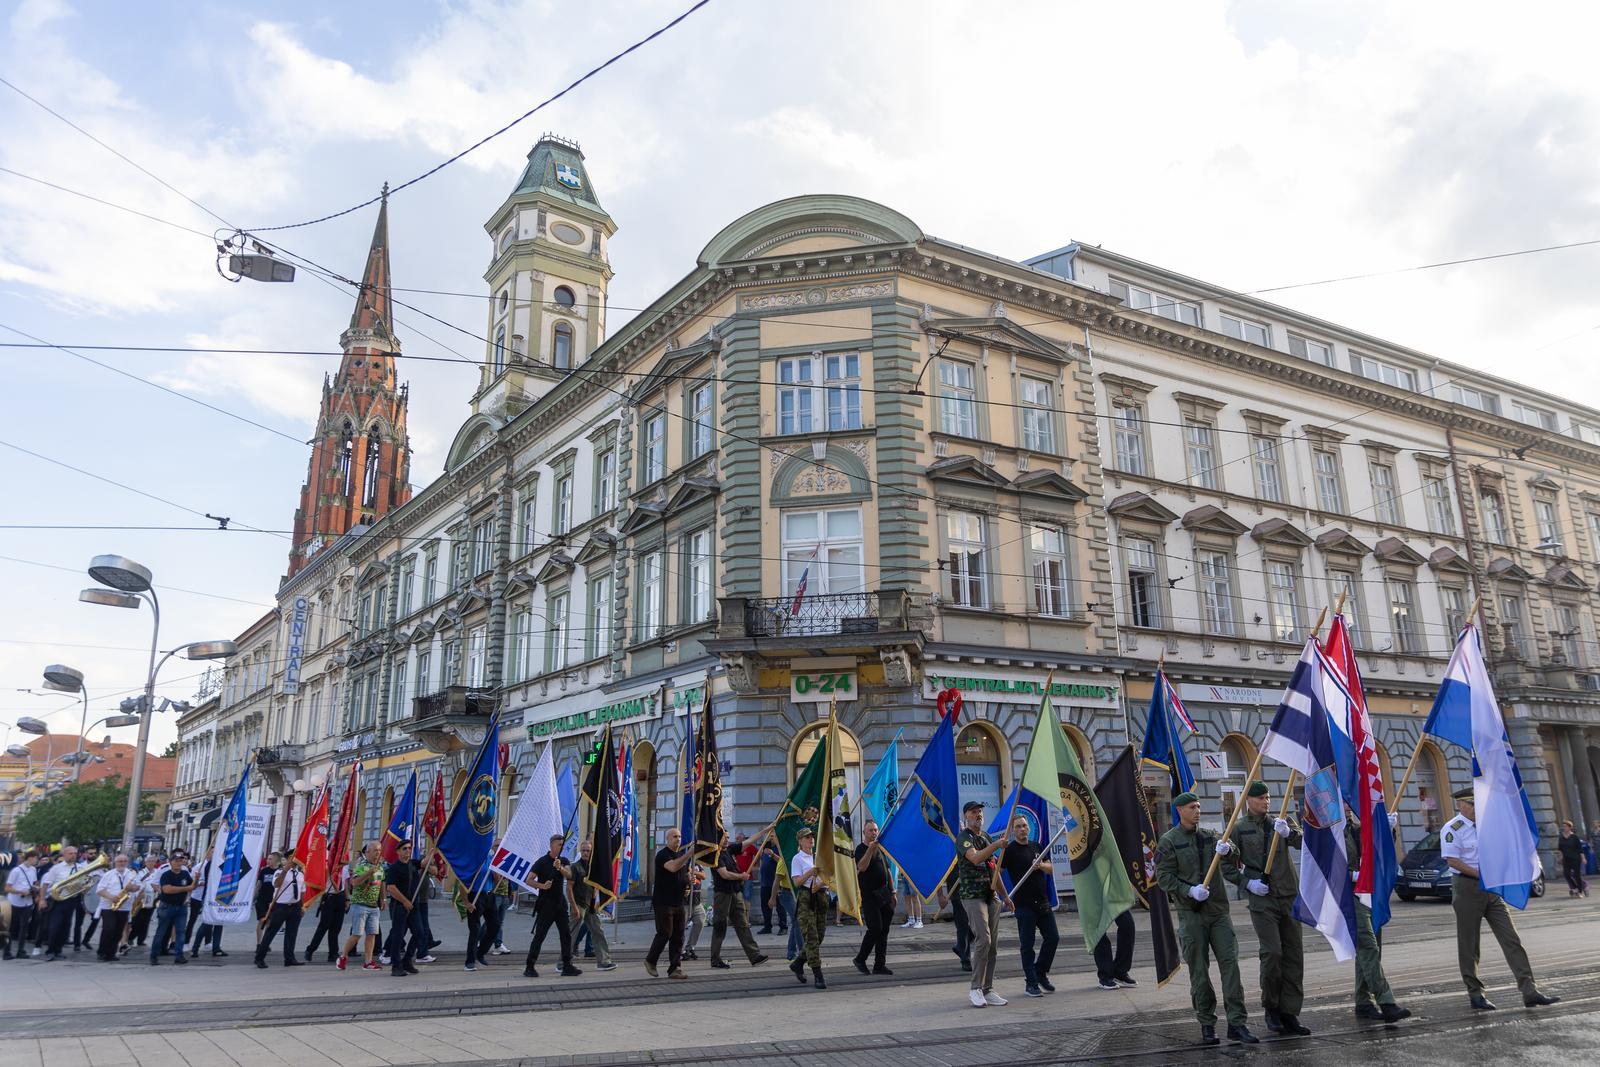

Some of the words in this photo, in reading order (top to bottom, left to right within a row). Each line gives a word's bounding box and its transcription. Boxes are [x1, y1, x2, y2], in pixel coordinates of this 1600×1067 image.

[287, 598, 307, 683] CENTRAL
[795, 673, 851, 694] 0-24
[944, 676, 1033, 693] CENTRALNA
[1224, 688, 1263, 697] NARODNE
[533, 712, 585, 736] CENTRALNA
[588, 698, 642, 727] LJEKARNA
[1068, 779, 1101, 831] HRVATSKA
